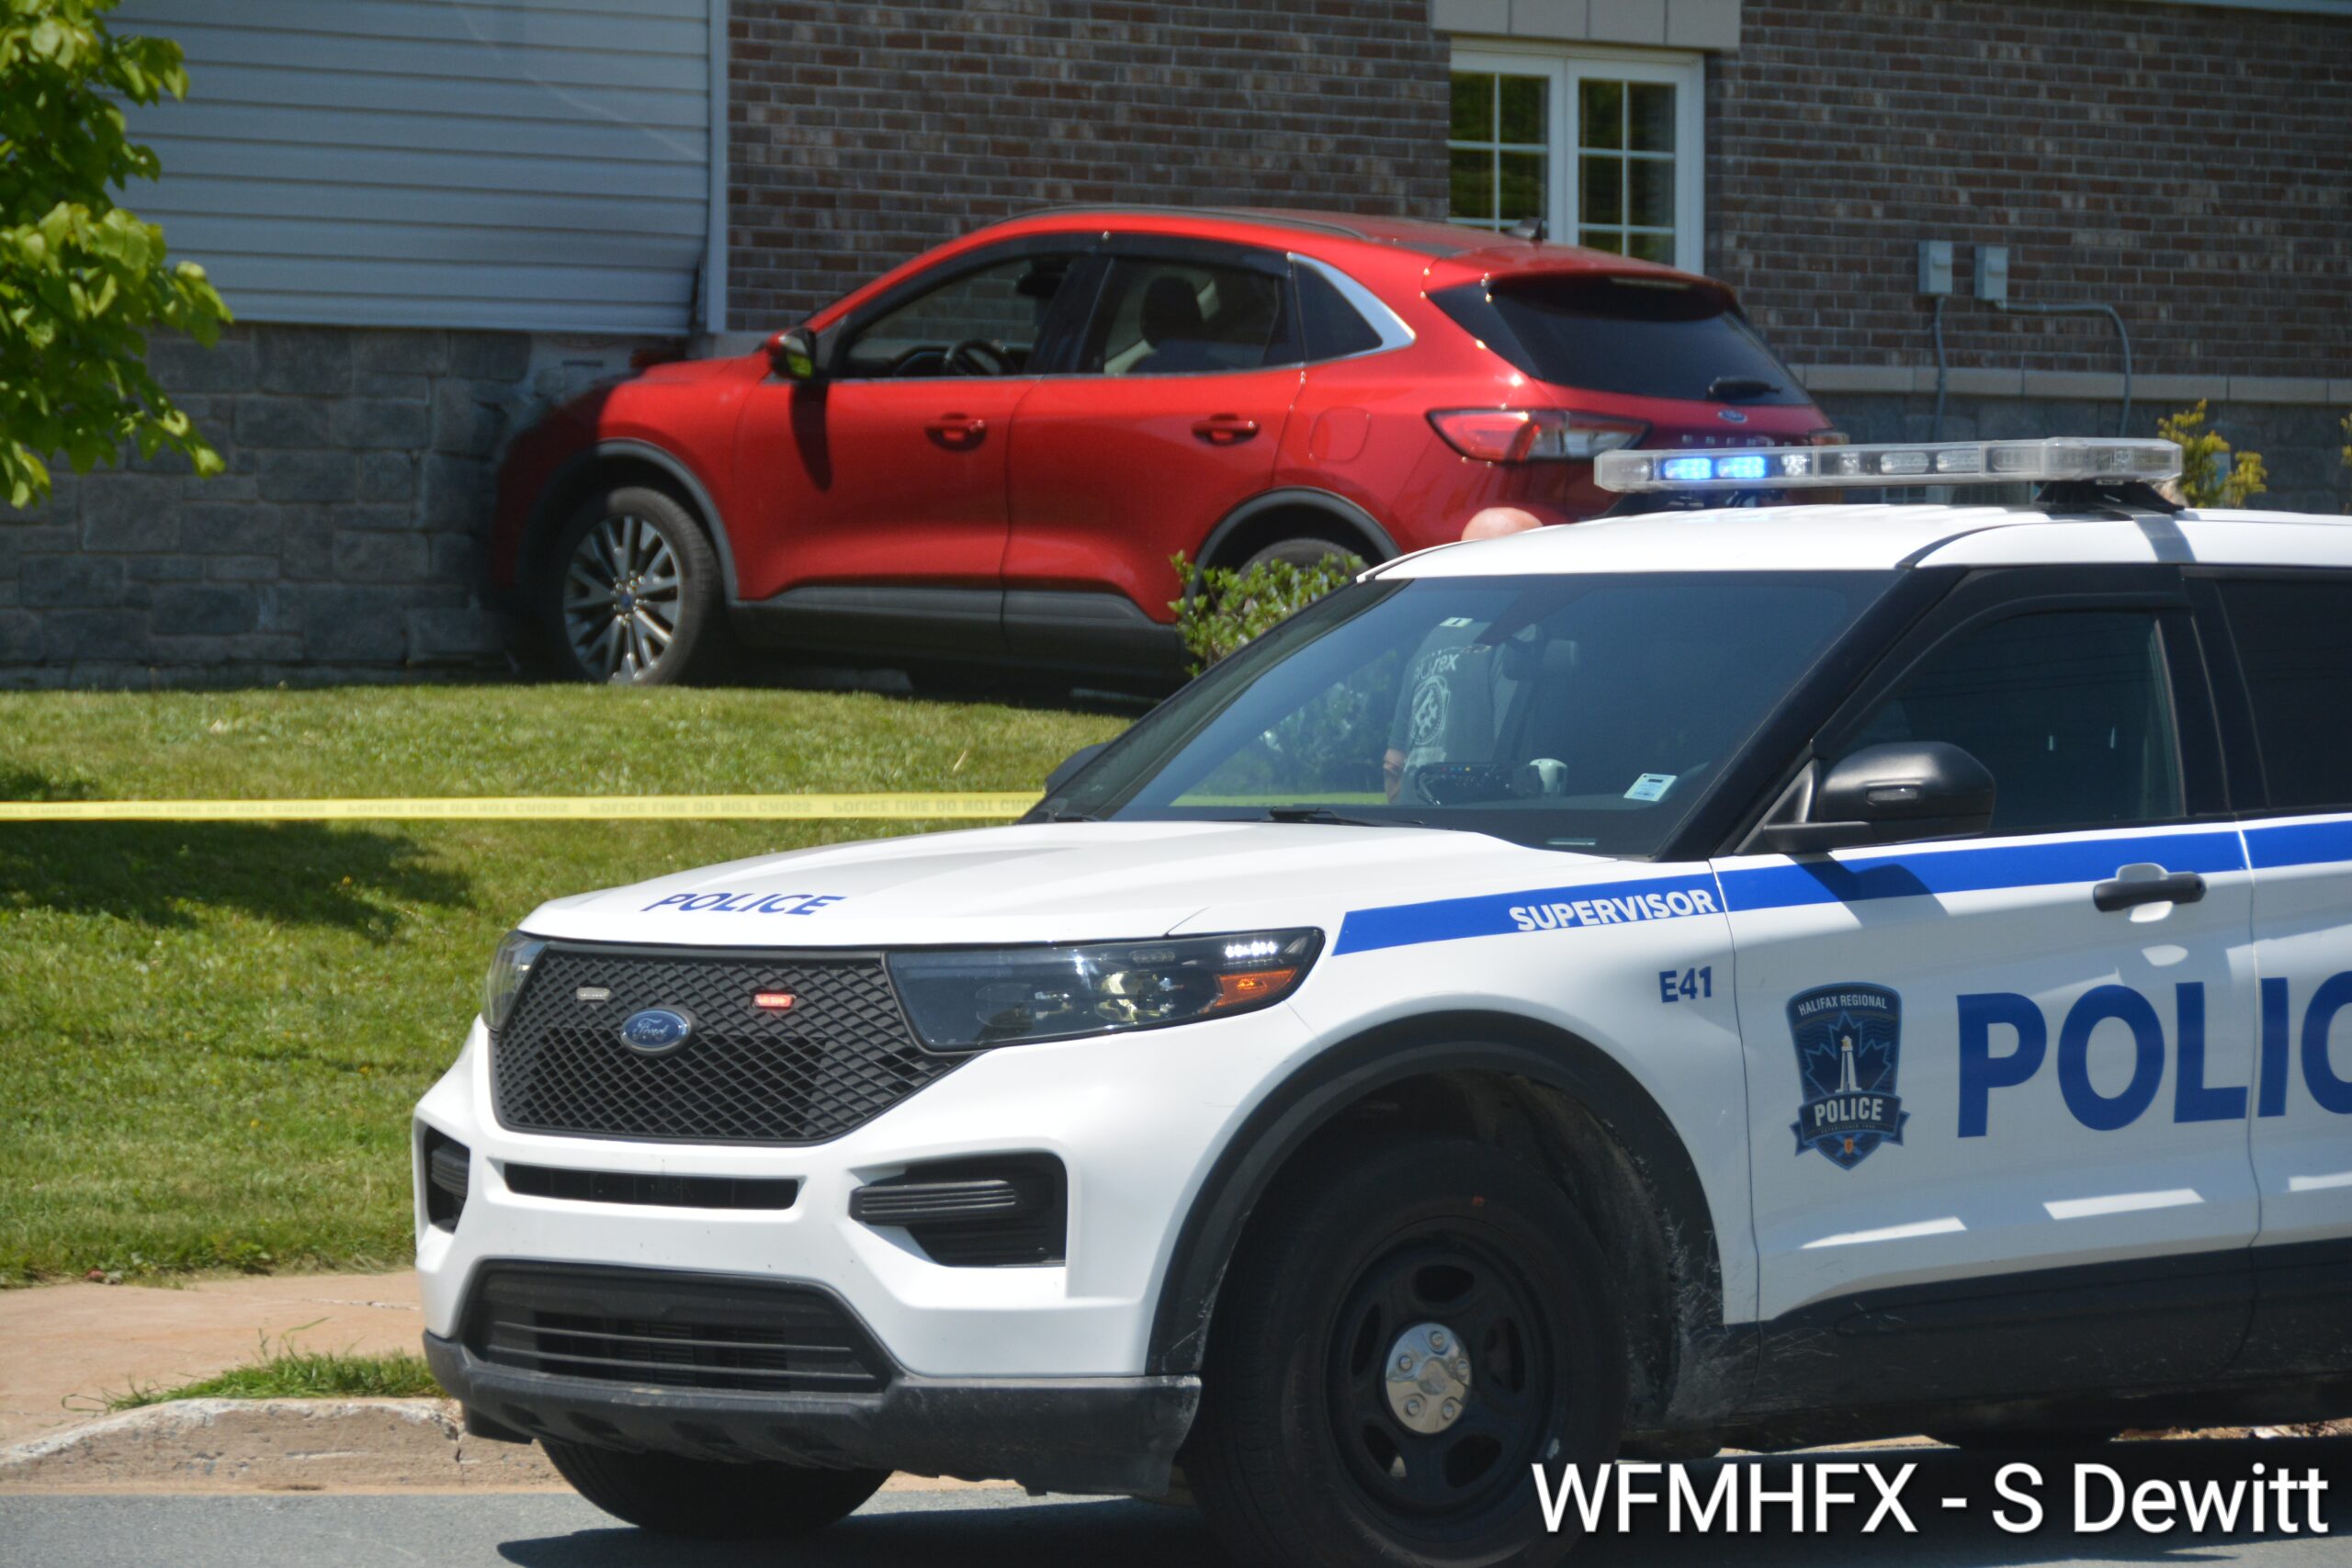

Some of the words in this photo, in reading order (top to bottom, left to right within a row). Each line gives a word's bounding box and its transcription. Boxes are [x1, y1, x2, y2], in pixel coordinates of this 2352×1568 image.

[639, 892, 846, 916] POLICE
[1509, 889, 1718, 931] SUPERVISOR
[1658, 966, 1712, 1003] E41
[1798, 996, 1838, 1017] HALIFAX
[1840, 994, 1887, 1010] REGIONAL
[1814, 1097, 1883, 1127] POLICE
